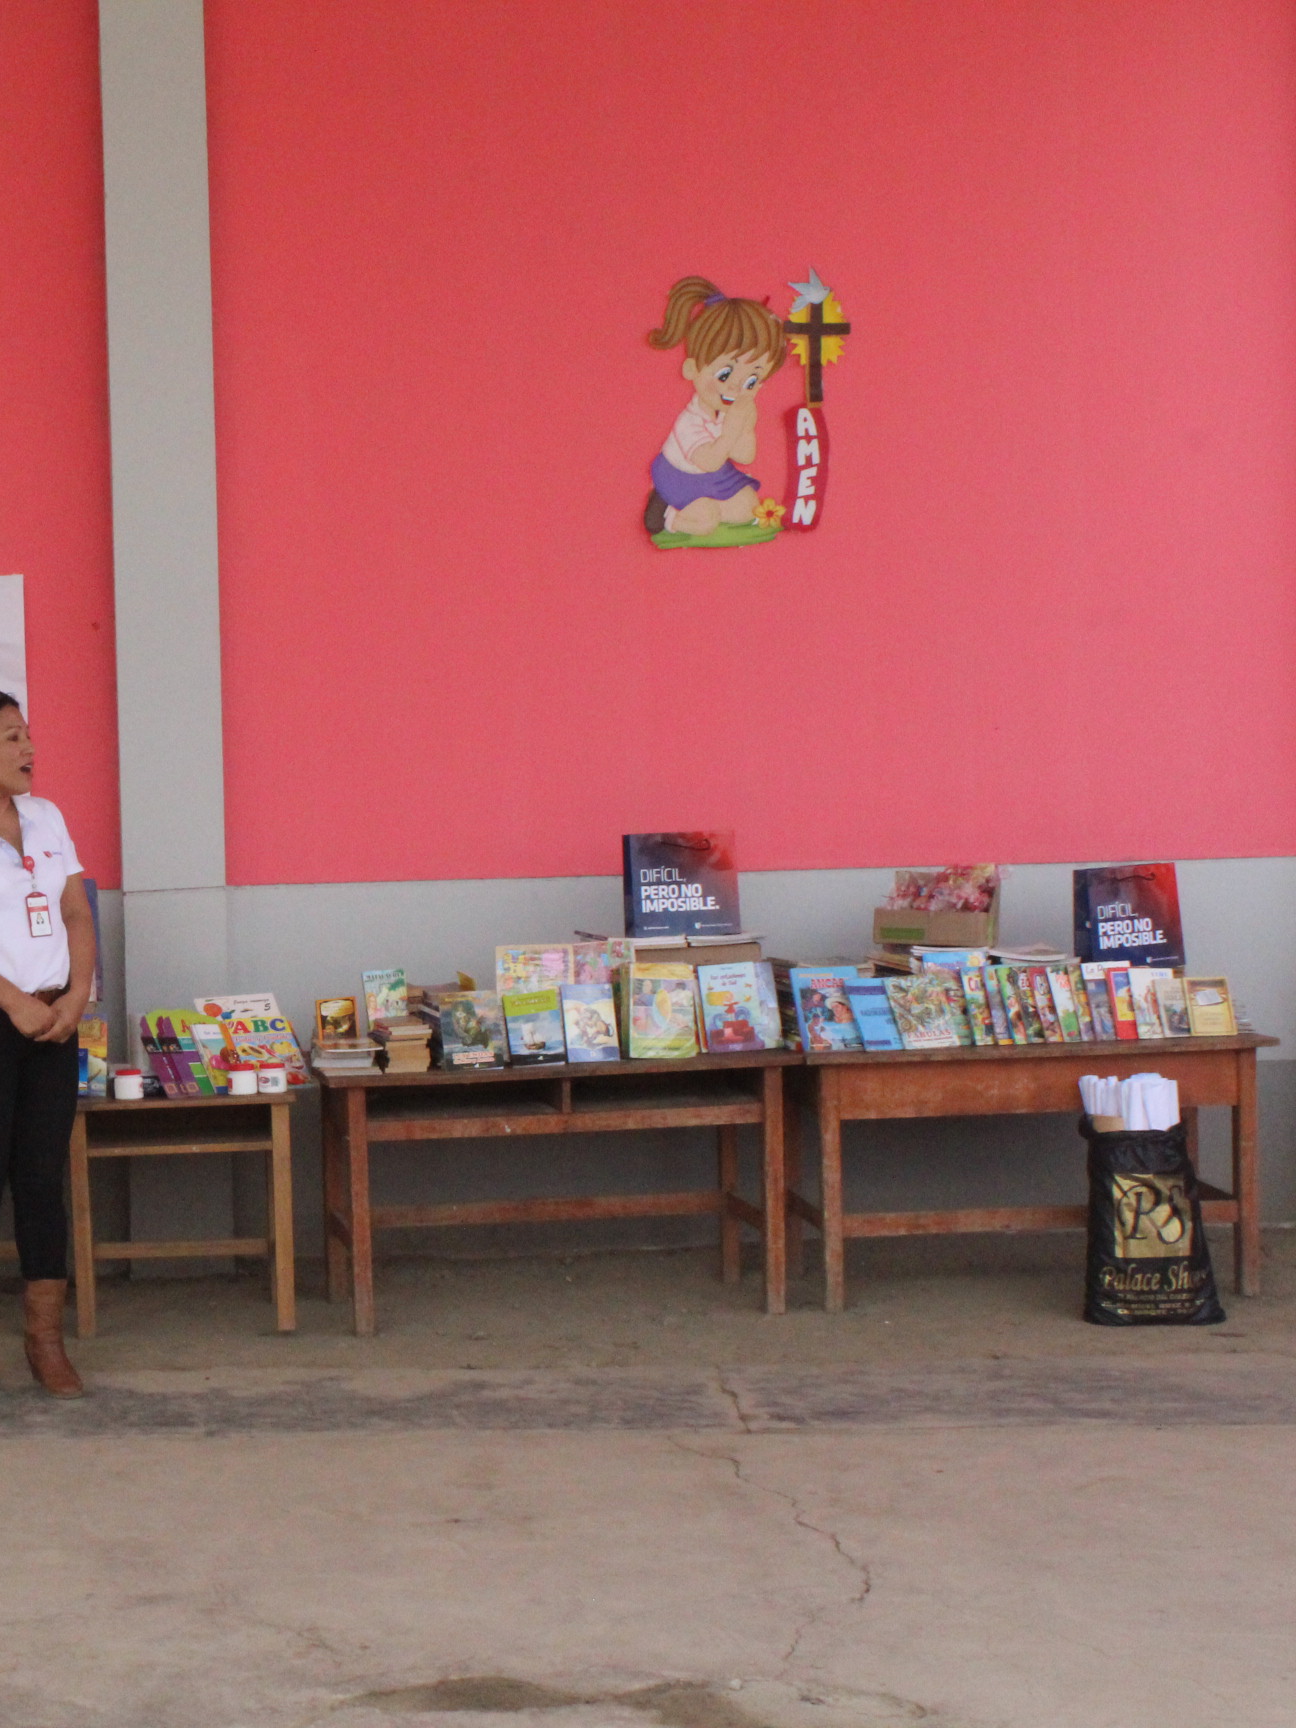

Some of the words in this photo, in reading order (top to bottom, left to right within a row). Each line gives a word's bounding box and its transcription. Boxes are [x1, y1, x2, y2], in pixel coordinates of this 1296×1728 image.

[792, 407, 820, 525] AMEN
[641, 885, 679, 900] PERO
[681, 883, 703, 898] NO
[641, 896, 721, 914] IMPOSIBLE.
[1098, 919, 1133, 936] PERO
[1134, 917, 1153, 933] NO
[1099, 930, 1168, 950] IMPOSIBLE.
[232, 1017, 287, 1035] ABC
[1099, 1262, 1161, 1292] Palace
